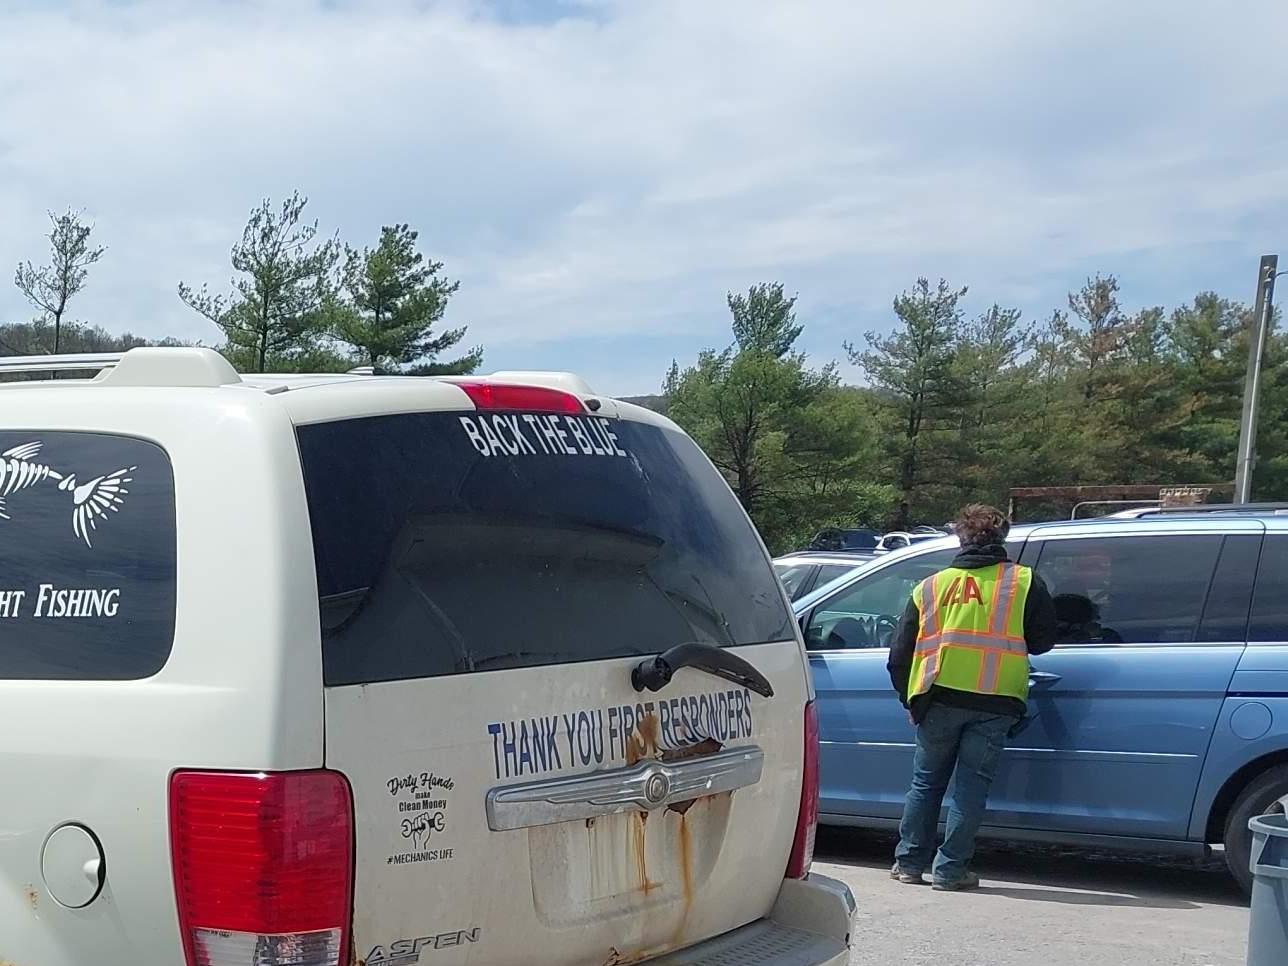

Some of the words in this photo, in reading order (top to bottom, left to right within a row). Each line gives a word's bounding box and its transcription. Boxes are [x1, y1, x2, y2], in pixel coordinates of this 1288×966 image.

[459, 414, 536, 457] BACK
[523, 413, 576, 455] THE
[567, 415, 627, 457] BLUE
[34, 584, 121, 618] FISHING
[488, 715, 562, 779] THANK
[563, 708, 603, 767] YOU
[608, 701, 655, 761] FIRST
[659, 688, 753, 749] RESPONDERS
[387, 774, 419, 796] Dirty
[420, 772, 455, 791] Hands
[415, 791, 431, 800] make
[399, 801, 422, 813] Clean
[422, 799, 447, 810] Money
[387, 849, 438, 865] #MECHANICS
[439, 848, 454, 860] LIFE
[364, 927, 481, 961] ASPEN
